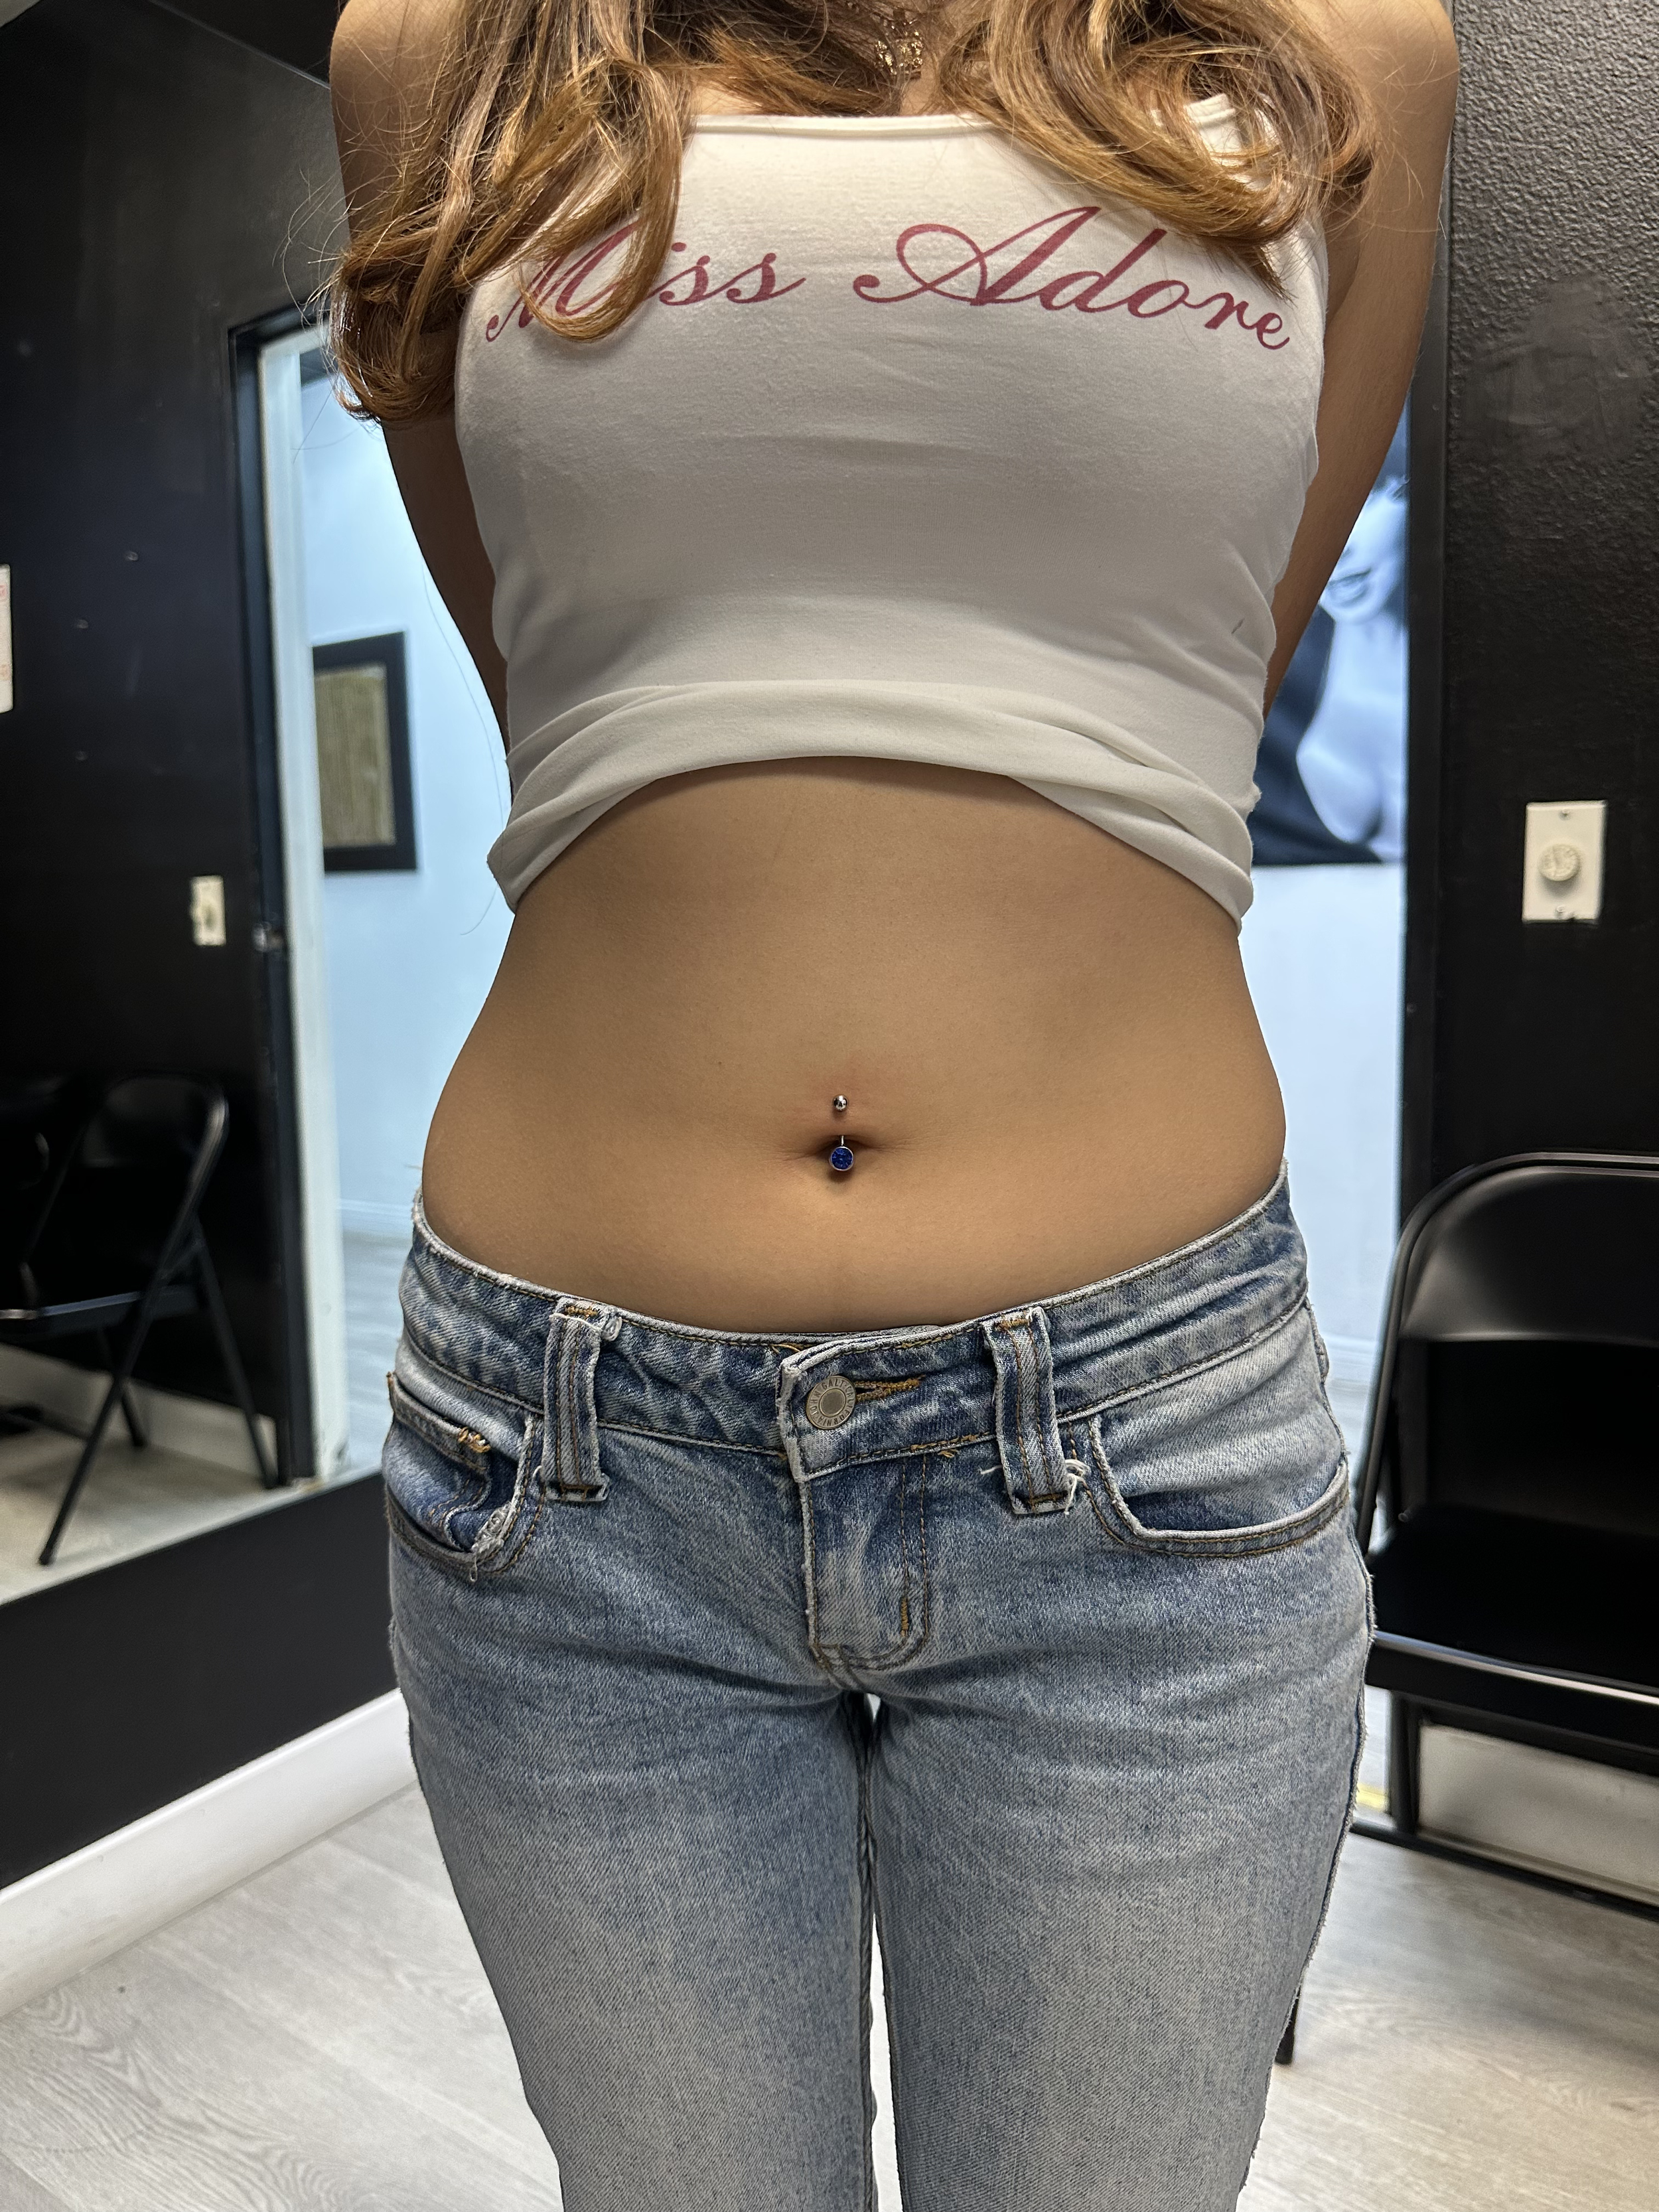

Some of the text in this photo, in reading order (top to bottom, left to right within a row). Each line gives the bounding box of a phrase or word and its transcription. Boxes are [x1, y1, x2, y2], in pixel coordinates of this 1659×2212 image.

[853, 206, 1291, 350] Adore
[810, 1378, 855, 1427] JOHN GALT CALIFORNIA
